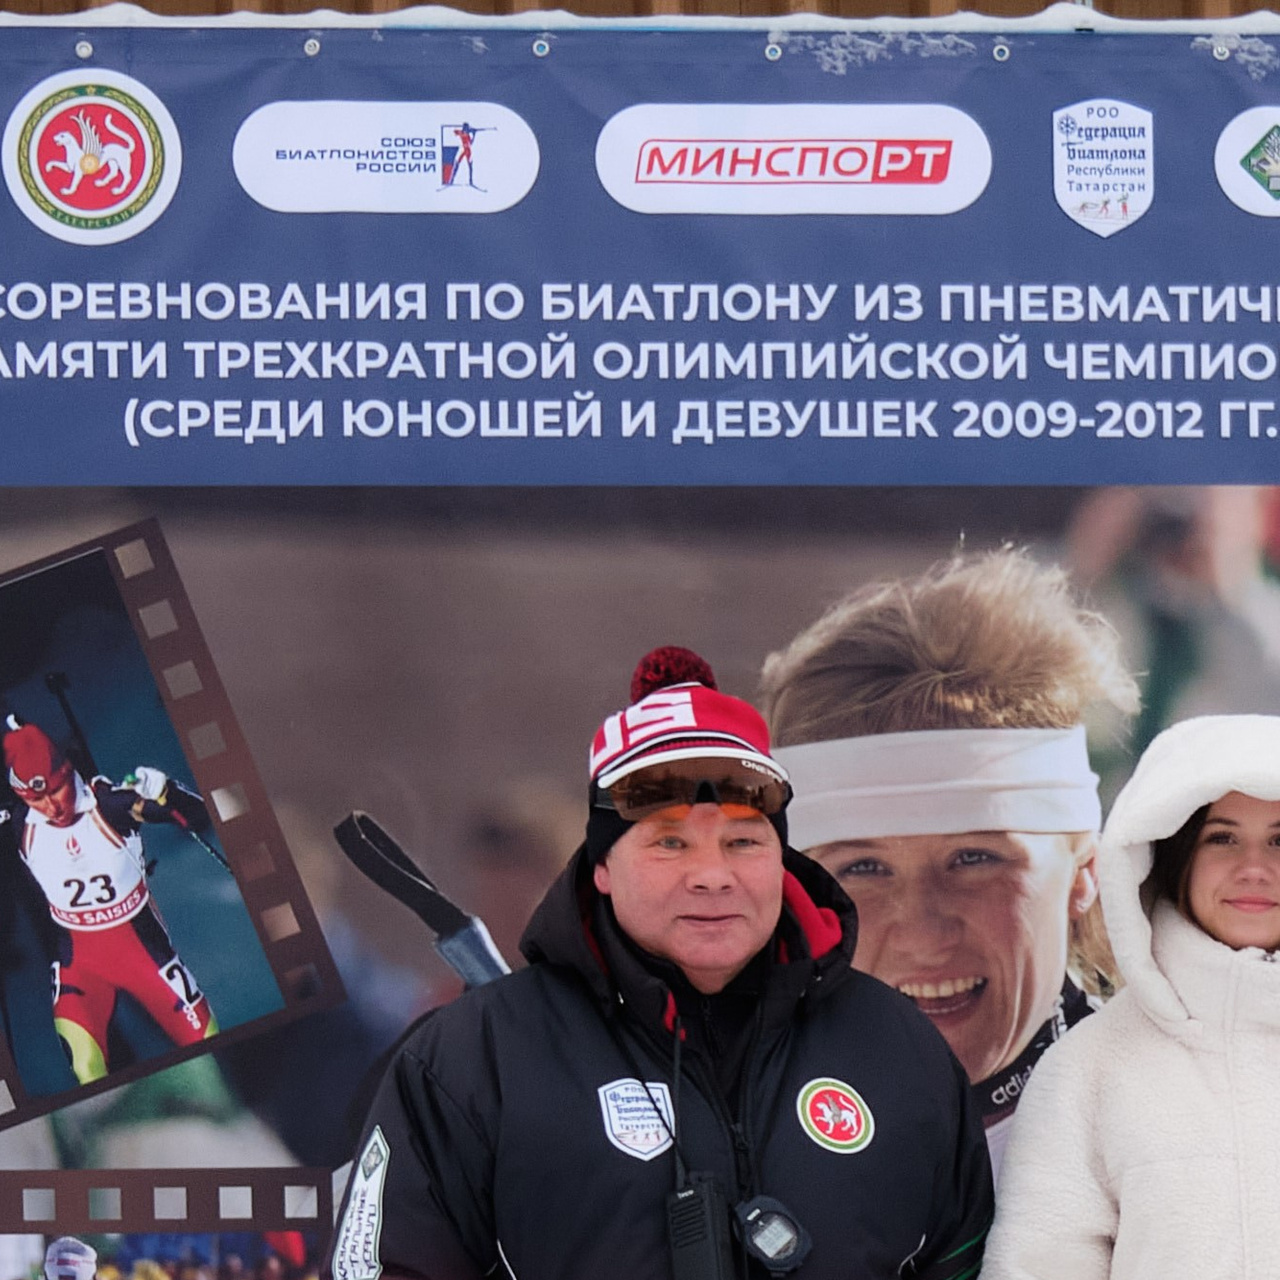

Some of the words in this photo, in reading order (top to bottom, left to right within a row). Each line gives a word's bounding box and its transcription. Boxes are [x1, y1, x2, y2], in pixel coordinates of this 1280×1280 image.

[1086, 107, 1120, 119] РОО
[380, 137, 437, 148] СОЮЗ
[275, 149, 437, 160] БИАТЛОНИСТОВ
[645, 145, 947, 178] МИНСПОРТ
[355, 162, 437, 173] РОССИИ
[1066, 164, 1146, 178] Республики
[1066, 181, 1146, 194] Татарстан
[447, 283, 524, 320] ПО
[542, 283, 837, 321] БИАТЛОНУ
[855, 283, 922, 321] ИЗ
[184, 332, 576, 379] ТРЕХКРАТНОЙ
[593, 332, 1027, 380] ОЛИМПИЙСКОЙ
[124, 399, 324, 446] (СРЕДИ
[343, 391, 602, 438] ЮНОШЕЙ
[621, 400, 656, 437] И
[672, 400, 939, 445] ДЕВУШЕК
[953, 400, 1204, 438] 2009-2012
[1220, 401, 1278, 438] ГГ.
[63, 874, 117, 908] 23
